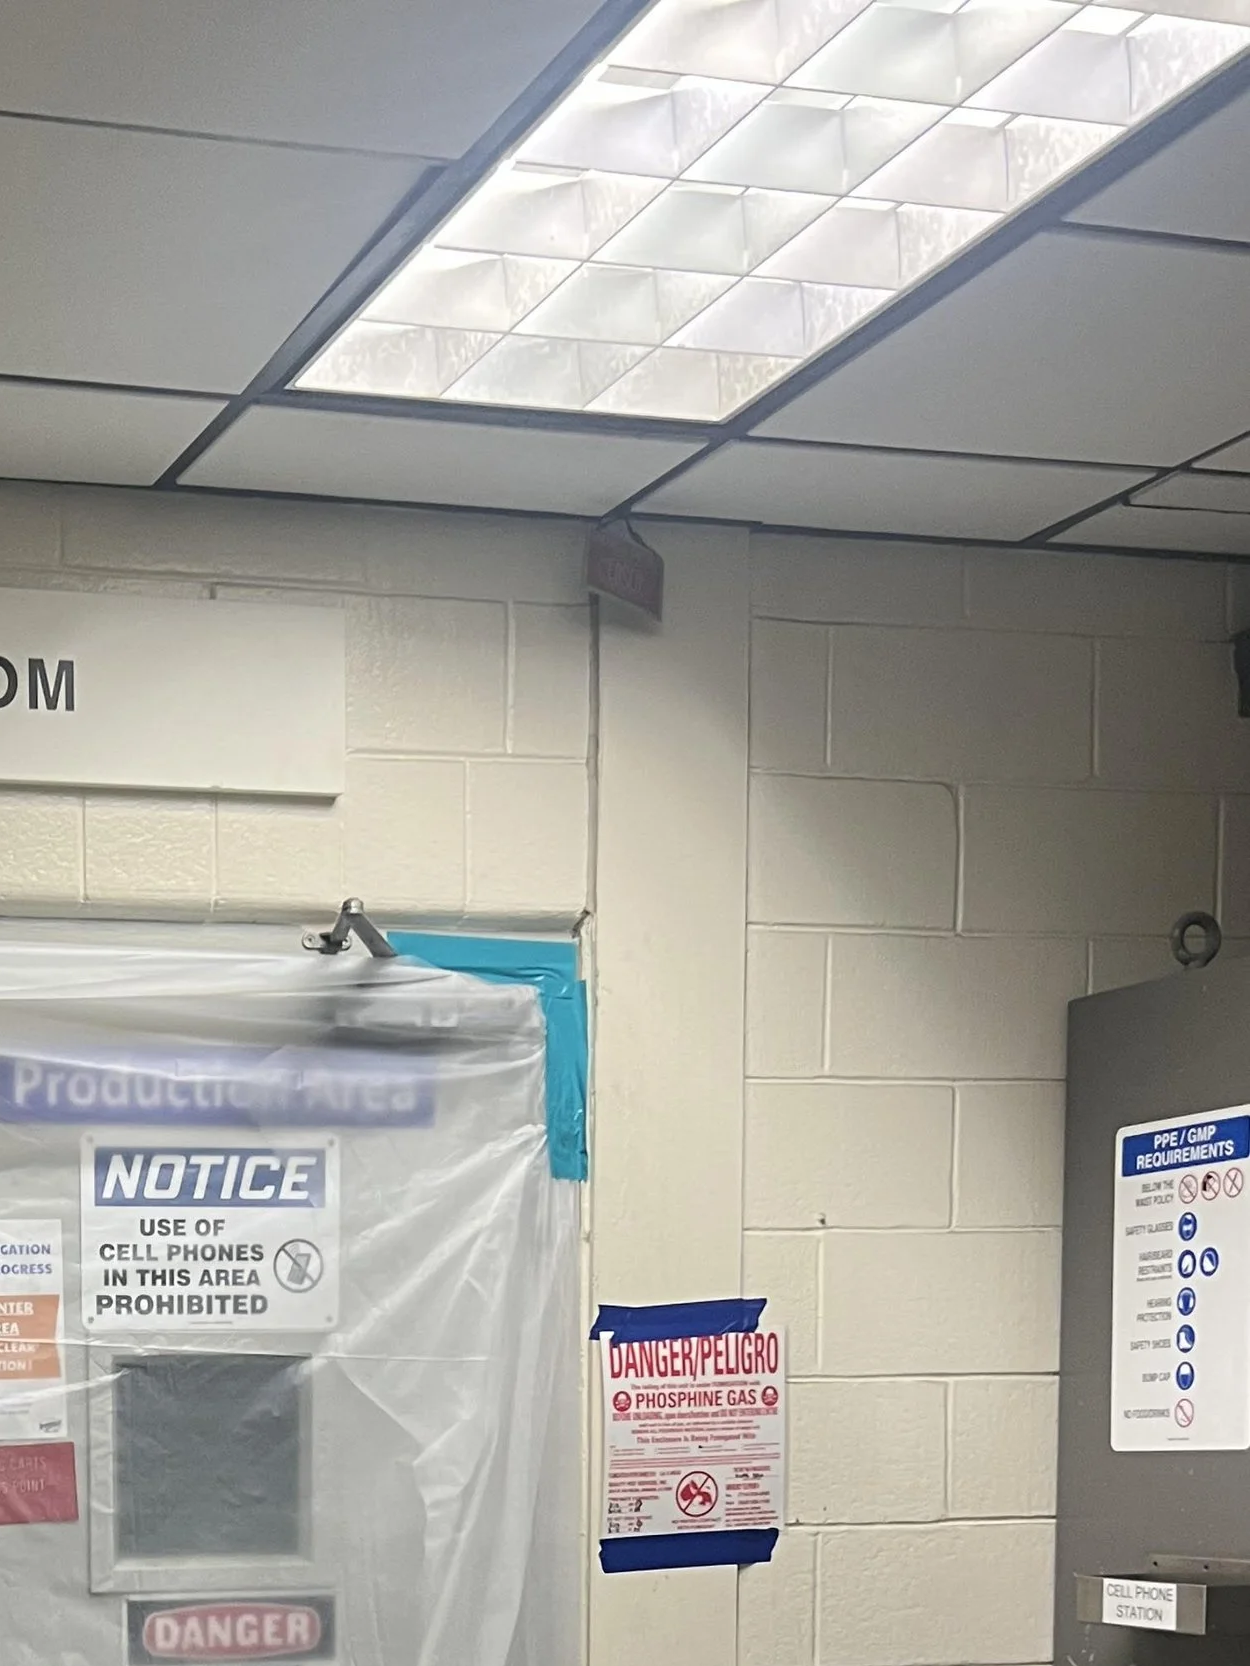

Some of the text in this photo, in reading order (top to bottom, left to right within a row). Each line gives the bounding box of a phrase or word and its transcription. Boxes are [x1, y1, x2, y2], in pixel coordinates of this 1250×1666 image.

[13, 1062, 418, 1112] Productio Area
[1154, 1130, 1180, 1150] PPE
[1187, 1124, 1217, 1144] GMP
[1136, 1139, 1235, 1170] REQUIREMENTS
[101, 1154, 318, 1201] NOTICE
[139, 1219, 226, 1237] USE OF
[98, 1243, 265, 1262] CELL PHONES
[103, 1269, 261, 1287] IN THIS AREA
[95, 1294, 269, 1316] PROHIBITED
[609, 1332, 779, 1381] DANGER/PELIGRO
[636, 1389, 757, 1410] PHOSPHINE GAS
[9, 1456, 47, 1471] CARTS
[1106, 1583, 1175, 1602] CELL PHONE
[1116, 1605, 1163, 1622] STATION
[154, 1612, 310, 1651] DANGER
